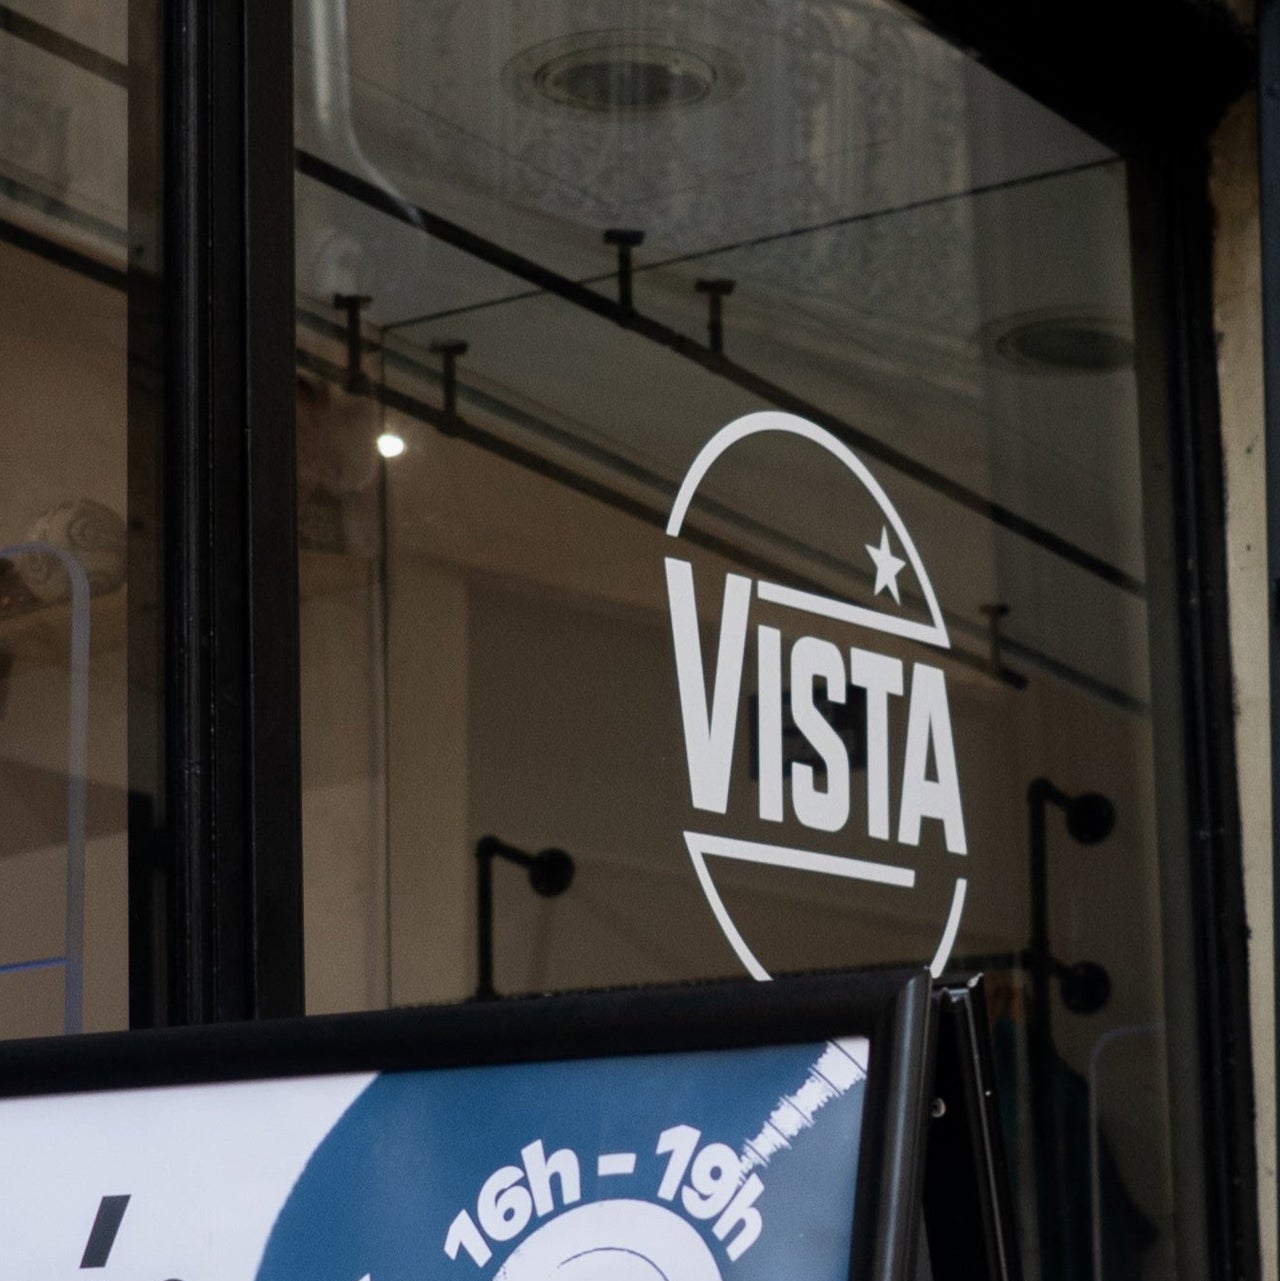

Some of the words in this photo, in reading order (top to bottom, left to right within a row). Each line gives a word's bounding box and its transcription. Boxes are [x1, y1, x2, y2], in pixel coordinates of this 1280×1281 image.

[664, 556, 968, 856] VISTA
[443, 1139, 581, 1268] 16h
[655, 1123, 764, 1262] 19h
